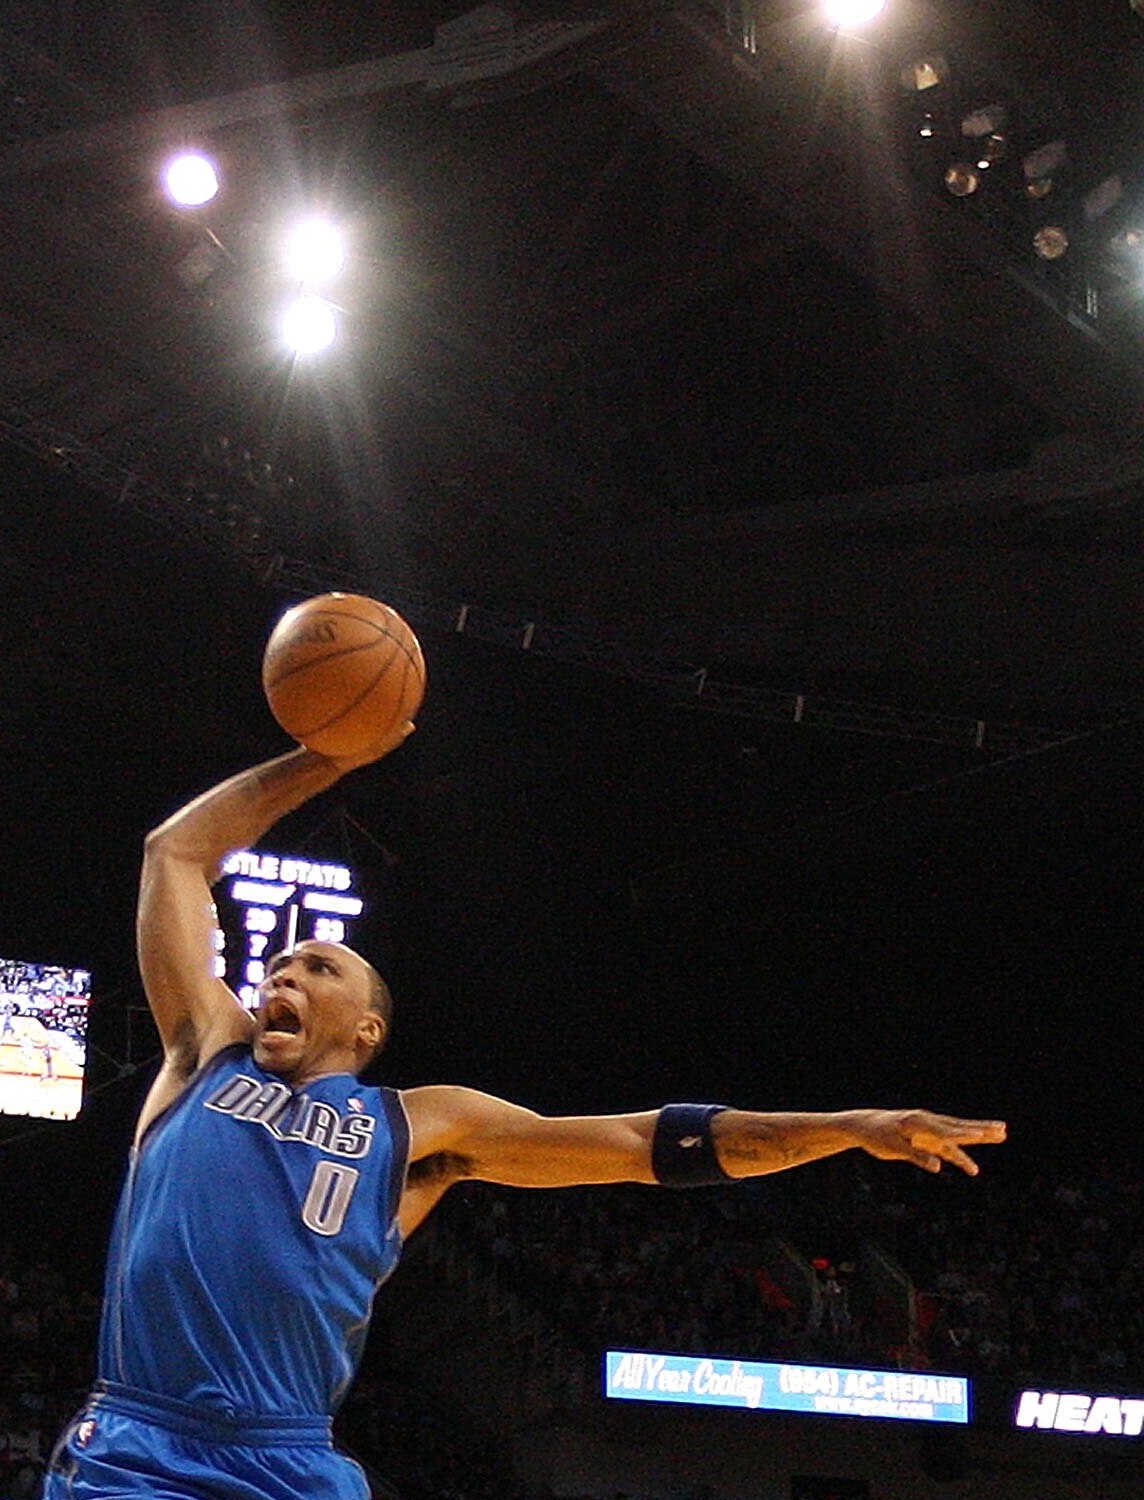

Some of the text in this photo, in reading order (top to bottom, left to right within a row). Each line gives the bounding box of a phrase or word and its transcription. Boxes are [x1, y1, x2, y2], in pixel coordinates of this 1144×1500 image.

[303, 1160, 360, 1236] 0
[612, 1354, 647, 1389] All
[693, 1359, 764, 1408] Cooling
[843, 1372, 963, 1404] AC-REPAIR
[1015, 1391, 1144, 1437] HEAT
